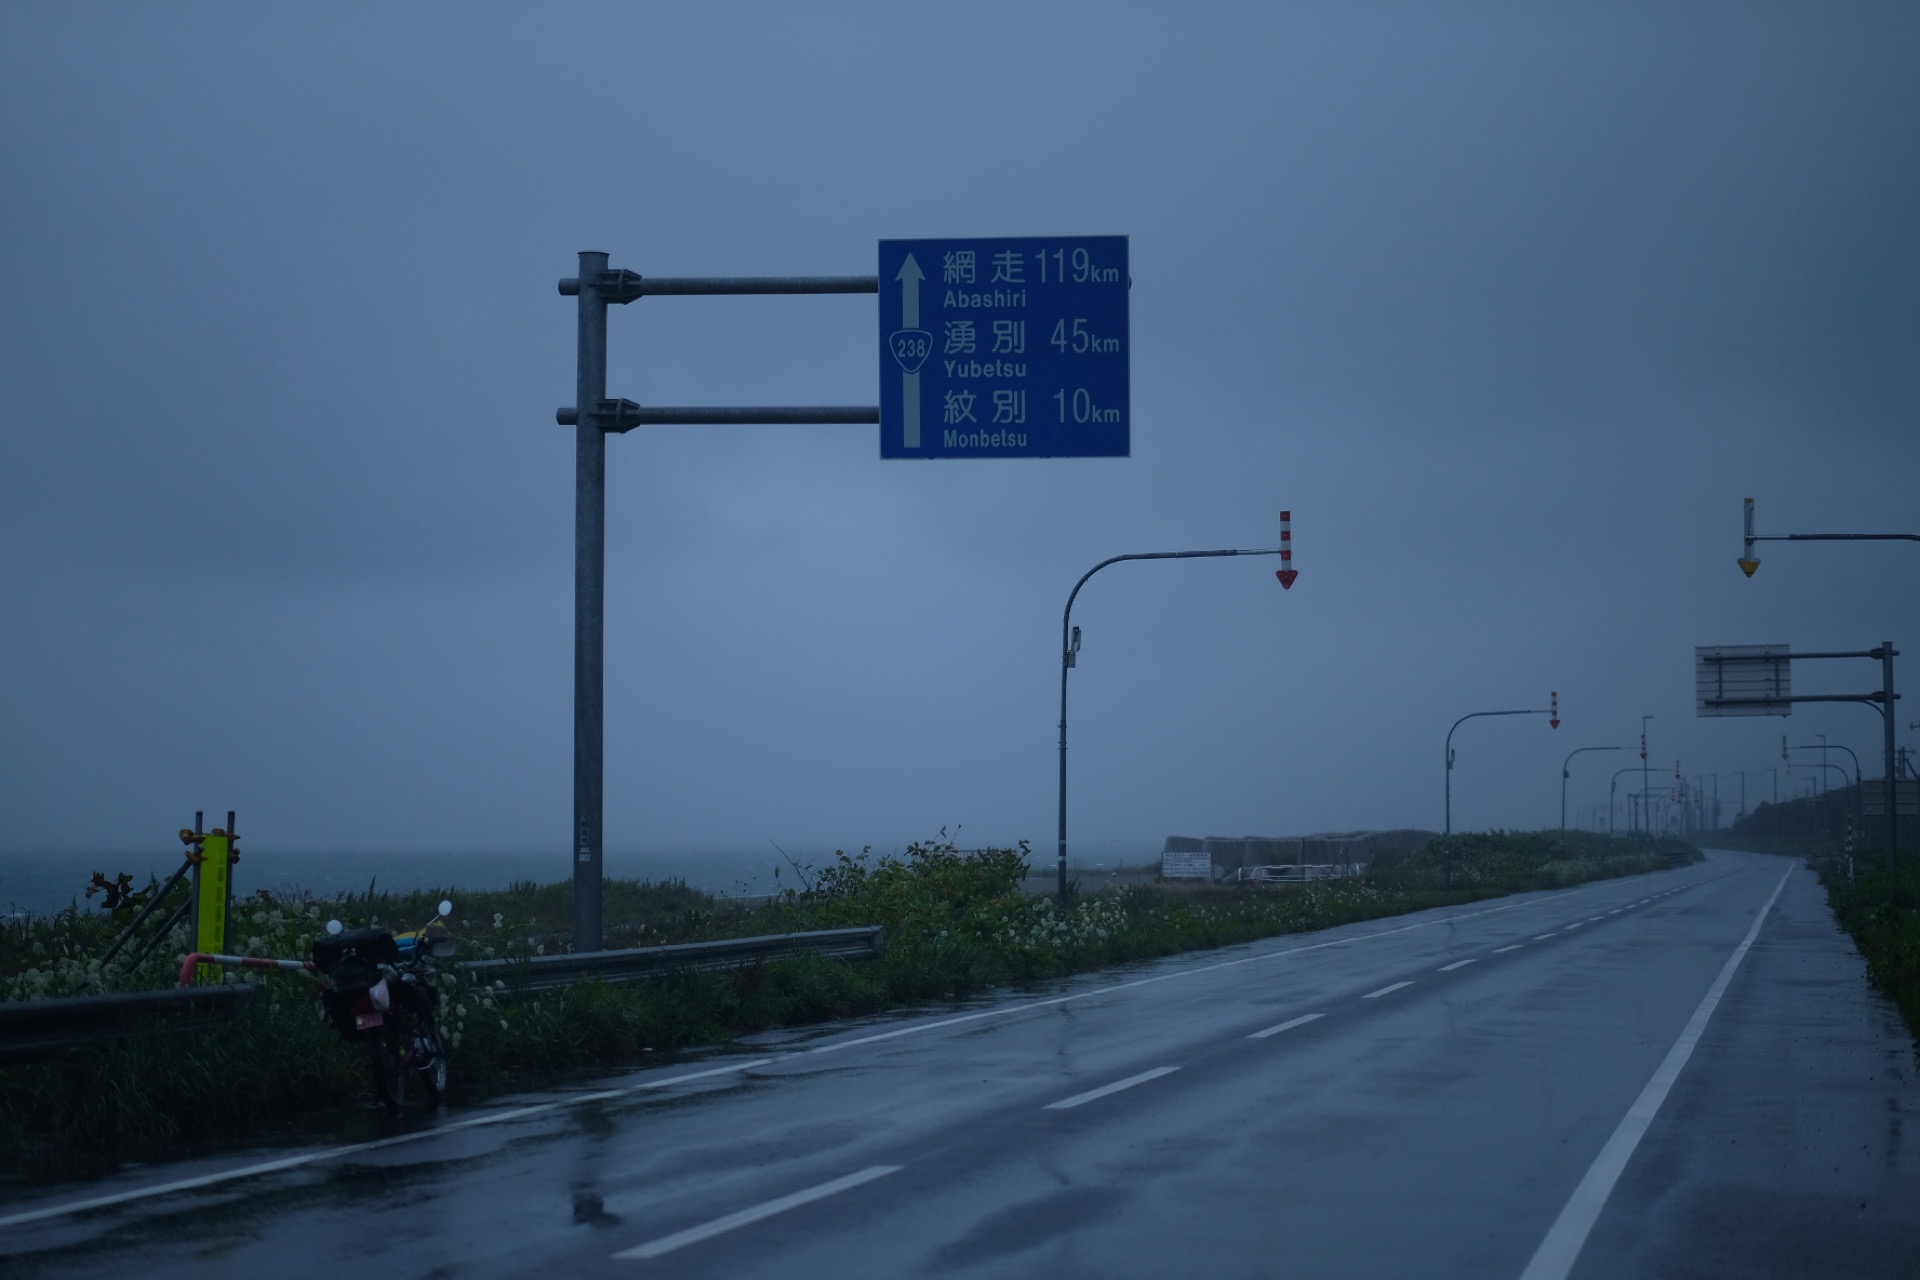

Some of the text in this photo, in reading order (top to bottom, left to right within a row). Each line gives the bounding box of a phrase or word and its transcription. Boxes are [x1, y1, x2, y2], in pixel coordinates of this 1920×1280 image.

[943, 247, 1120, 284] 網走 119km
[943, 289, 1026, 308] Abashiri
[943, 318, 1120, 354] 湧別 45km
[897, 338, 926, 358] 238
[943, 359, 1027, 378] Yubetsu
[943, 387, 1121, 424] 紋別 10km
[943, 429, 1027, 448] Monbetsu
